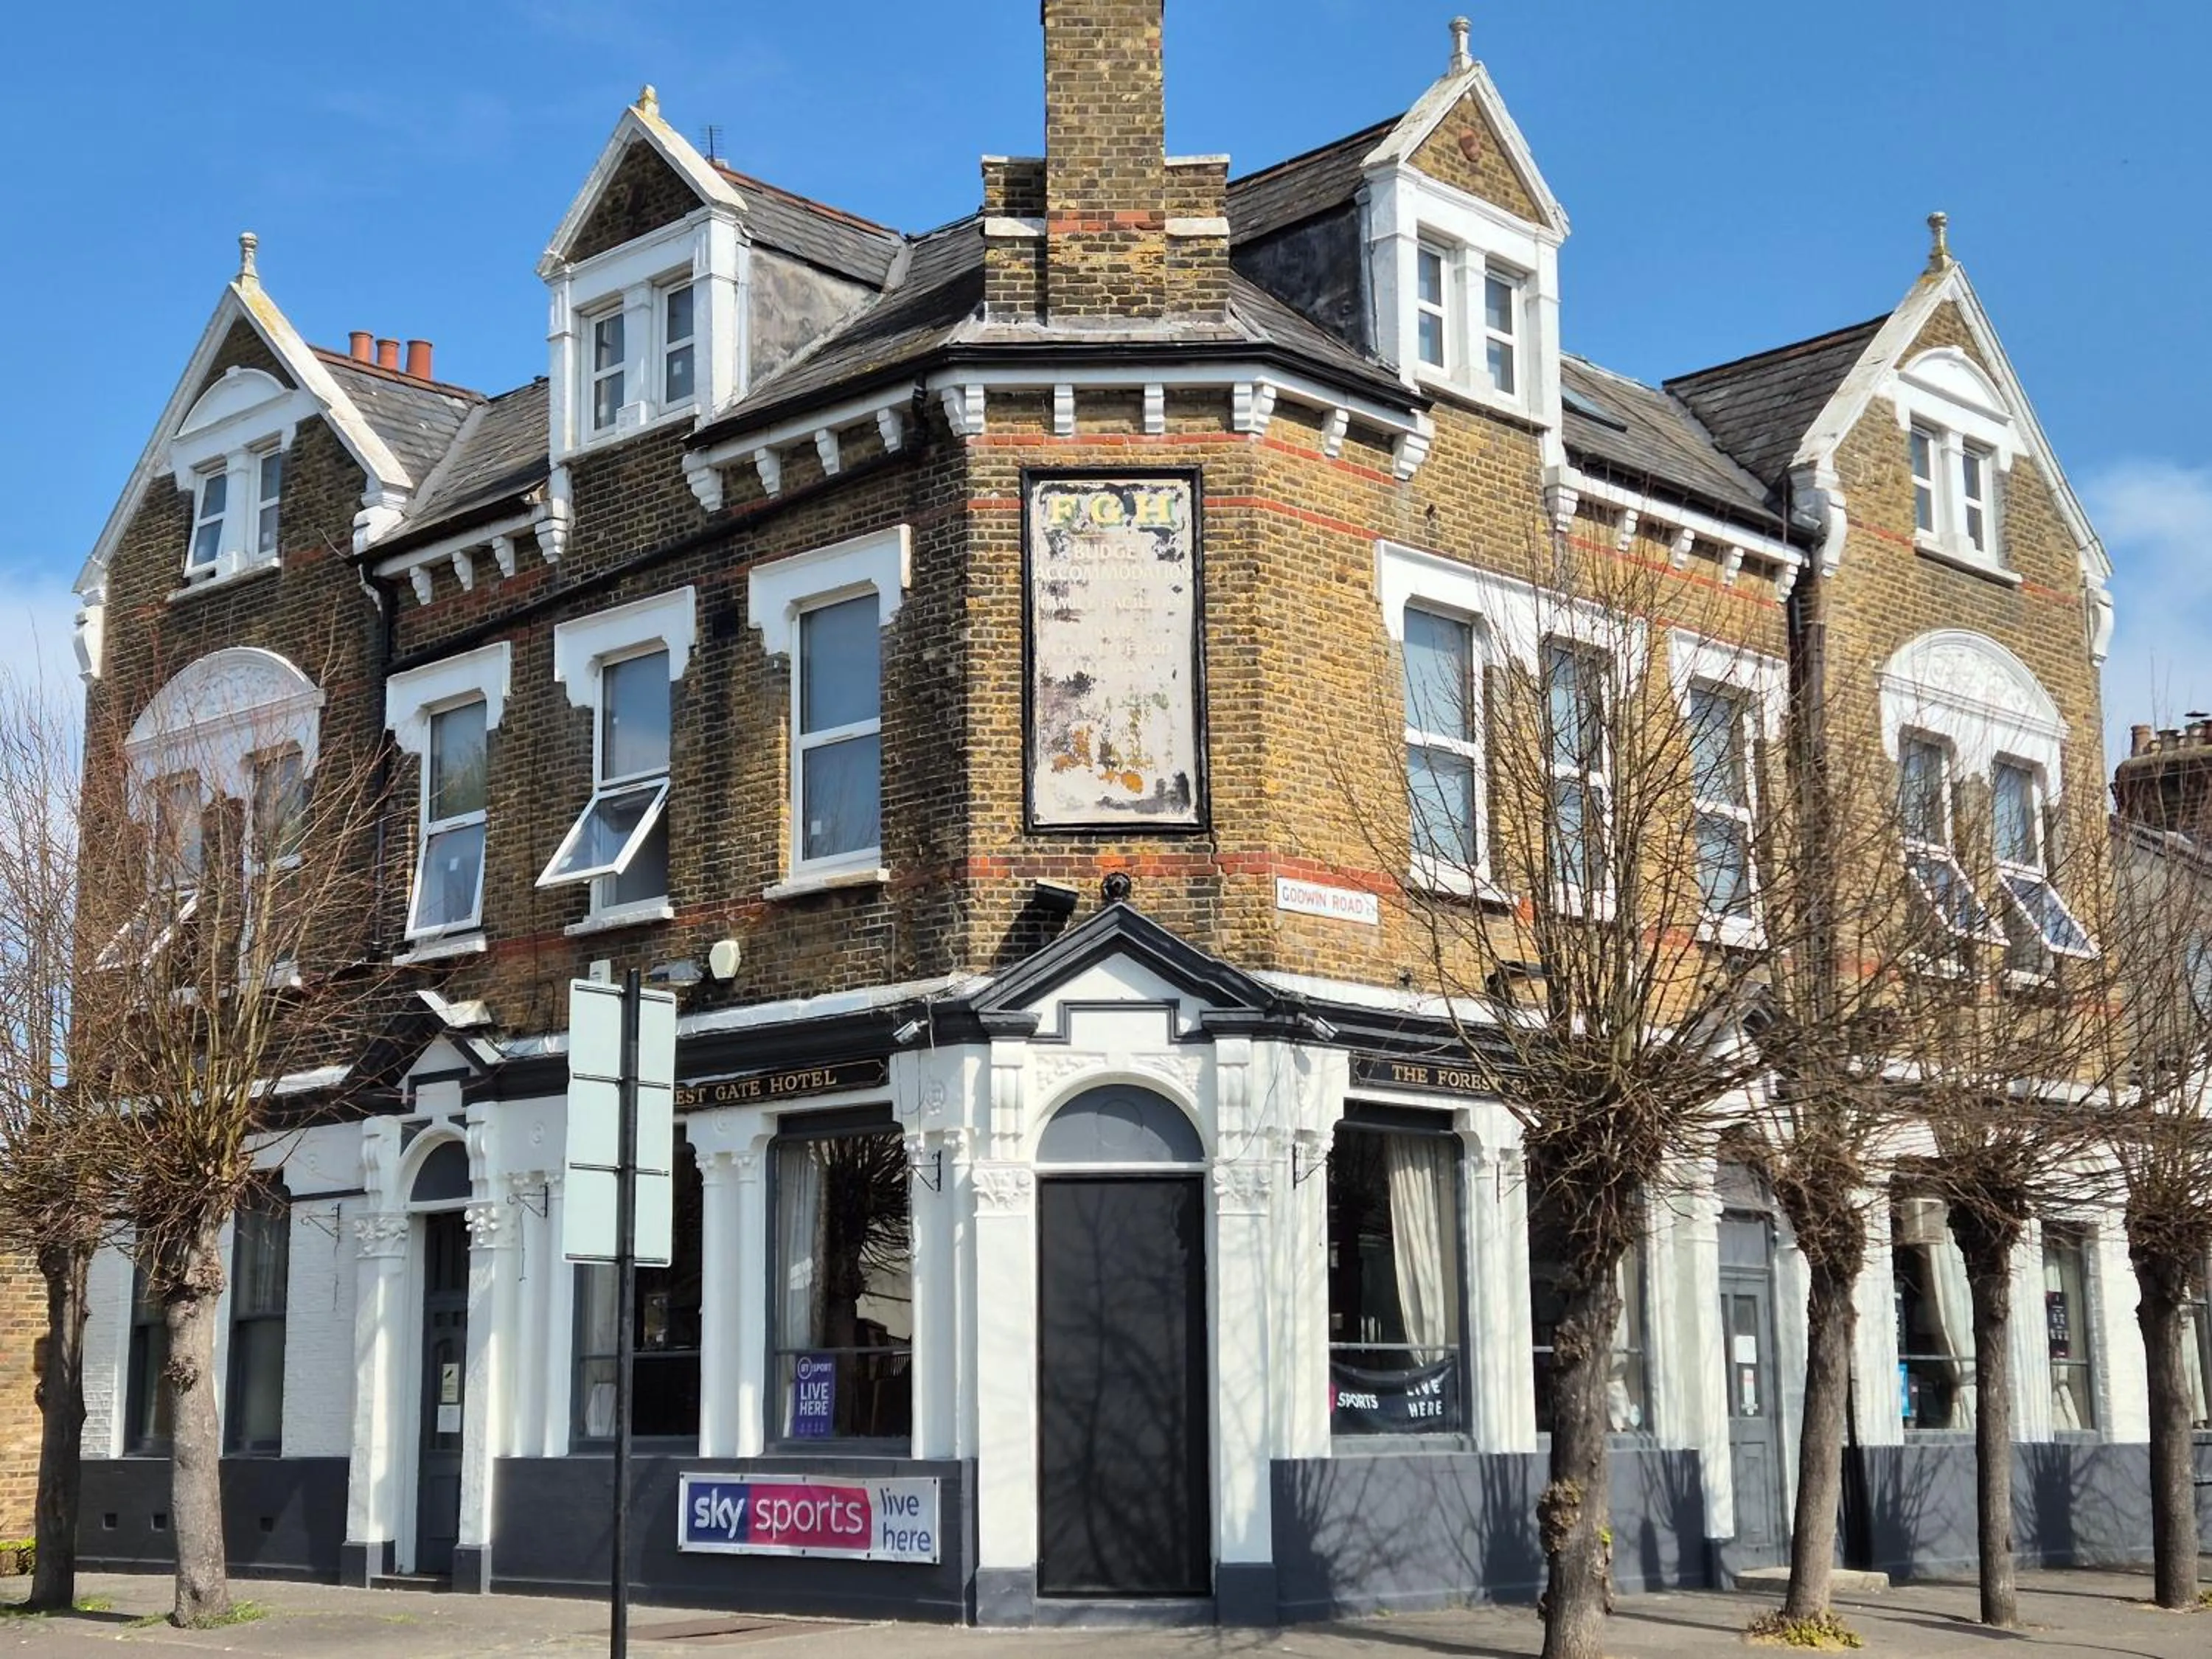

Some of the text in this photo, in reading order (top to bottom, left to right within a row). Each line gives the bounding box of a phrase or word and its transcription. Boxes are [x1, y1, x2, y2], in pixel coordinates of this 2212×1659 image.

[1073, 544, 1147, 560] BUDGET
[1034, 564, 1192, 580] ACCOMMODATION
[1281, 885, 1327, 908] GODWIN
[1332, 894, 1363, 914] ROAD
[1391, 1064, 1429, 1083] THE
[715, 1079, 760, 1102] GATE
[770, 1069, 837, 1094] HOTEL
[813, 1362, 832, 1372] SPORT
[800, 1382, 830, 1401] LIVE
[1406, 1378, 1441, 1397] LIVE
[799, 1401, 828, 1416] HERE
[1337, 1391, 1379, 1410] SPORTS
[1408, 1400, 1443, 1418] HERE
[880, 1486, 920, 1517] live
[694, 1487, 863, 1540] sky sports
[883, 1522, 931, 1553] here
